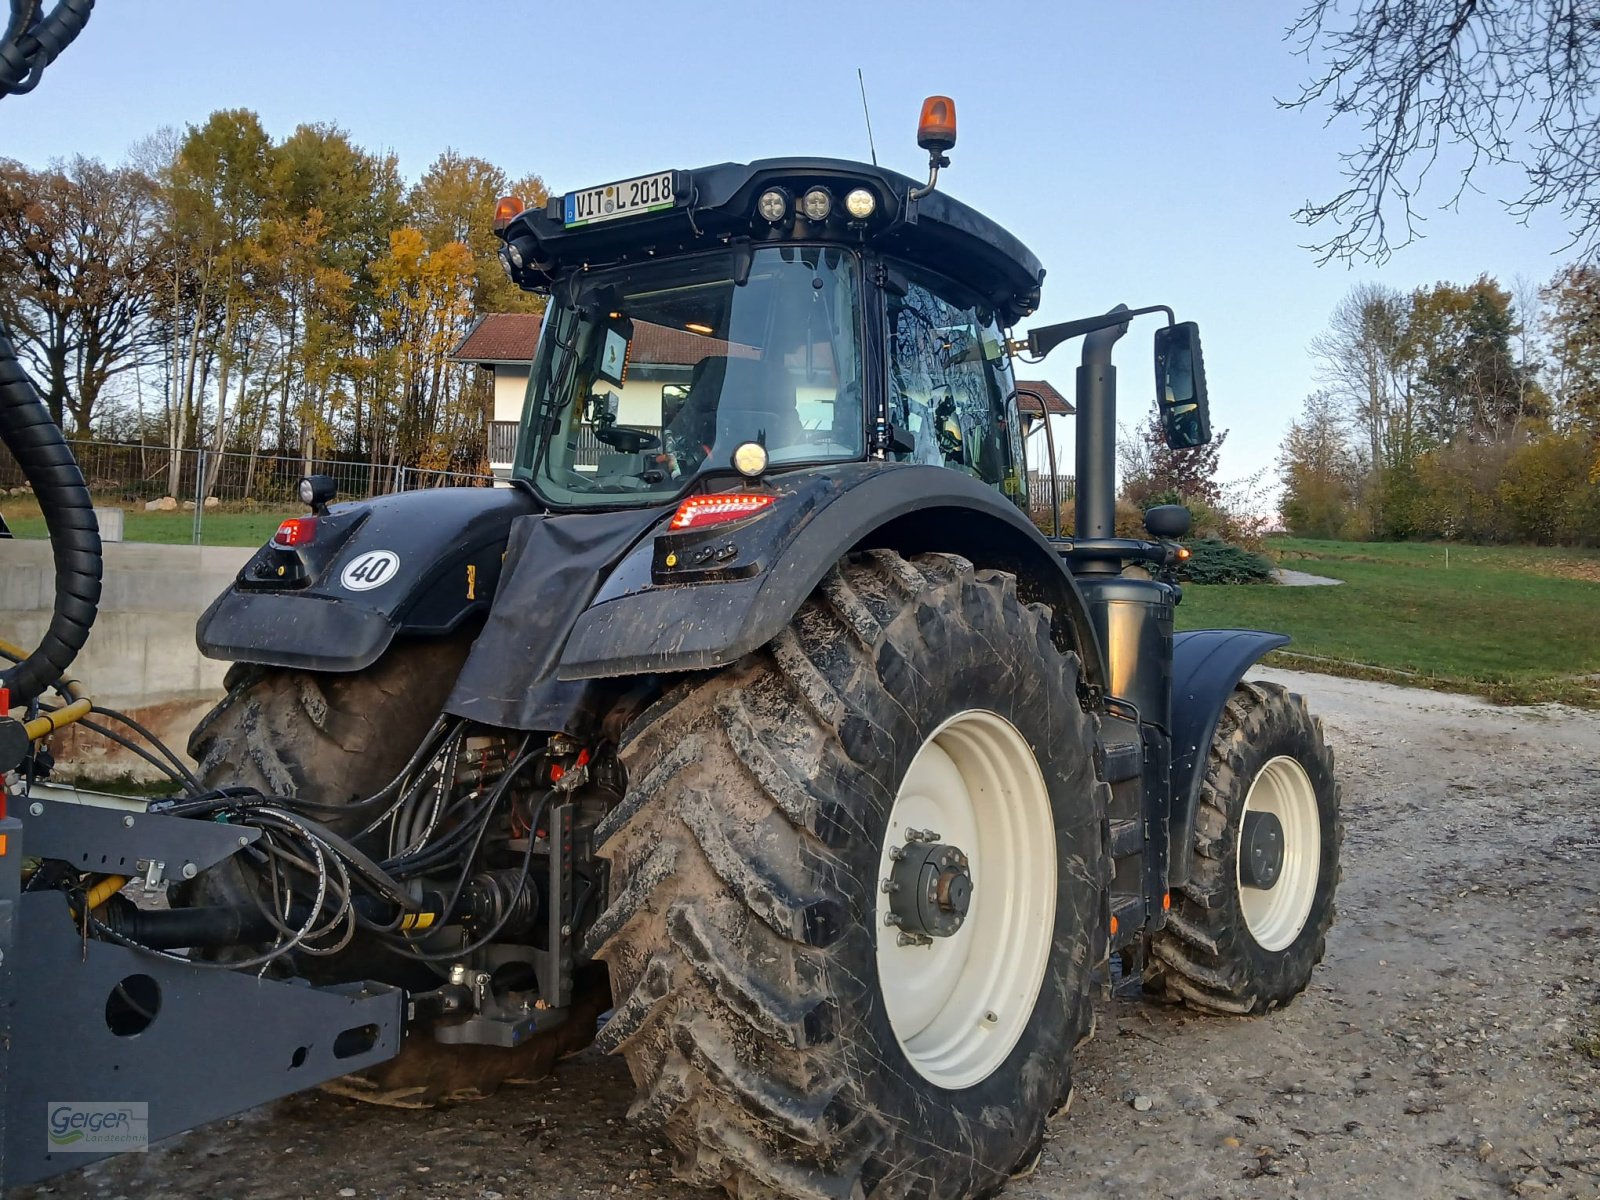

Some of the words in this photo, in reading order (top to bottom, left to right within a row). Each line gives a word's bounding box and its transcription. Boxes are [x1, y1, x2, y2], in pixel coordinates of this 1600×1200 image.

[576, 189, 604, 218] VIT
[616, 186, 626, 210] L
[630, 176, 671, 207] 2018
[349, 556, 391, 583] 40
